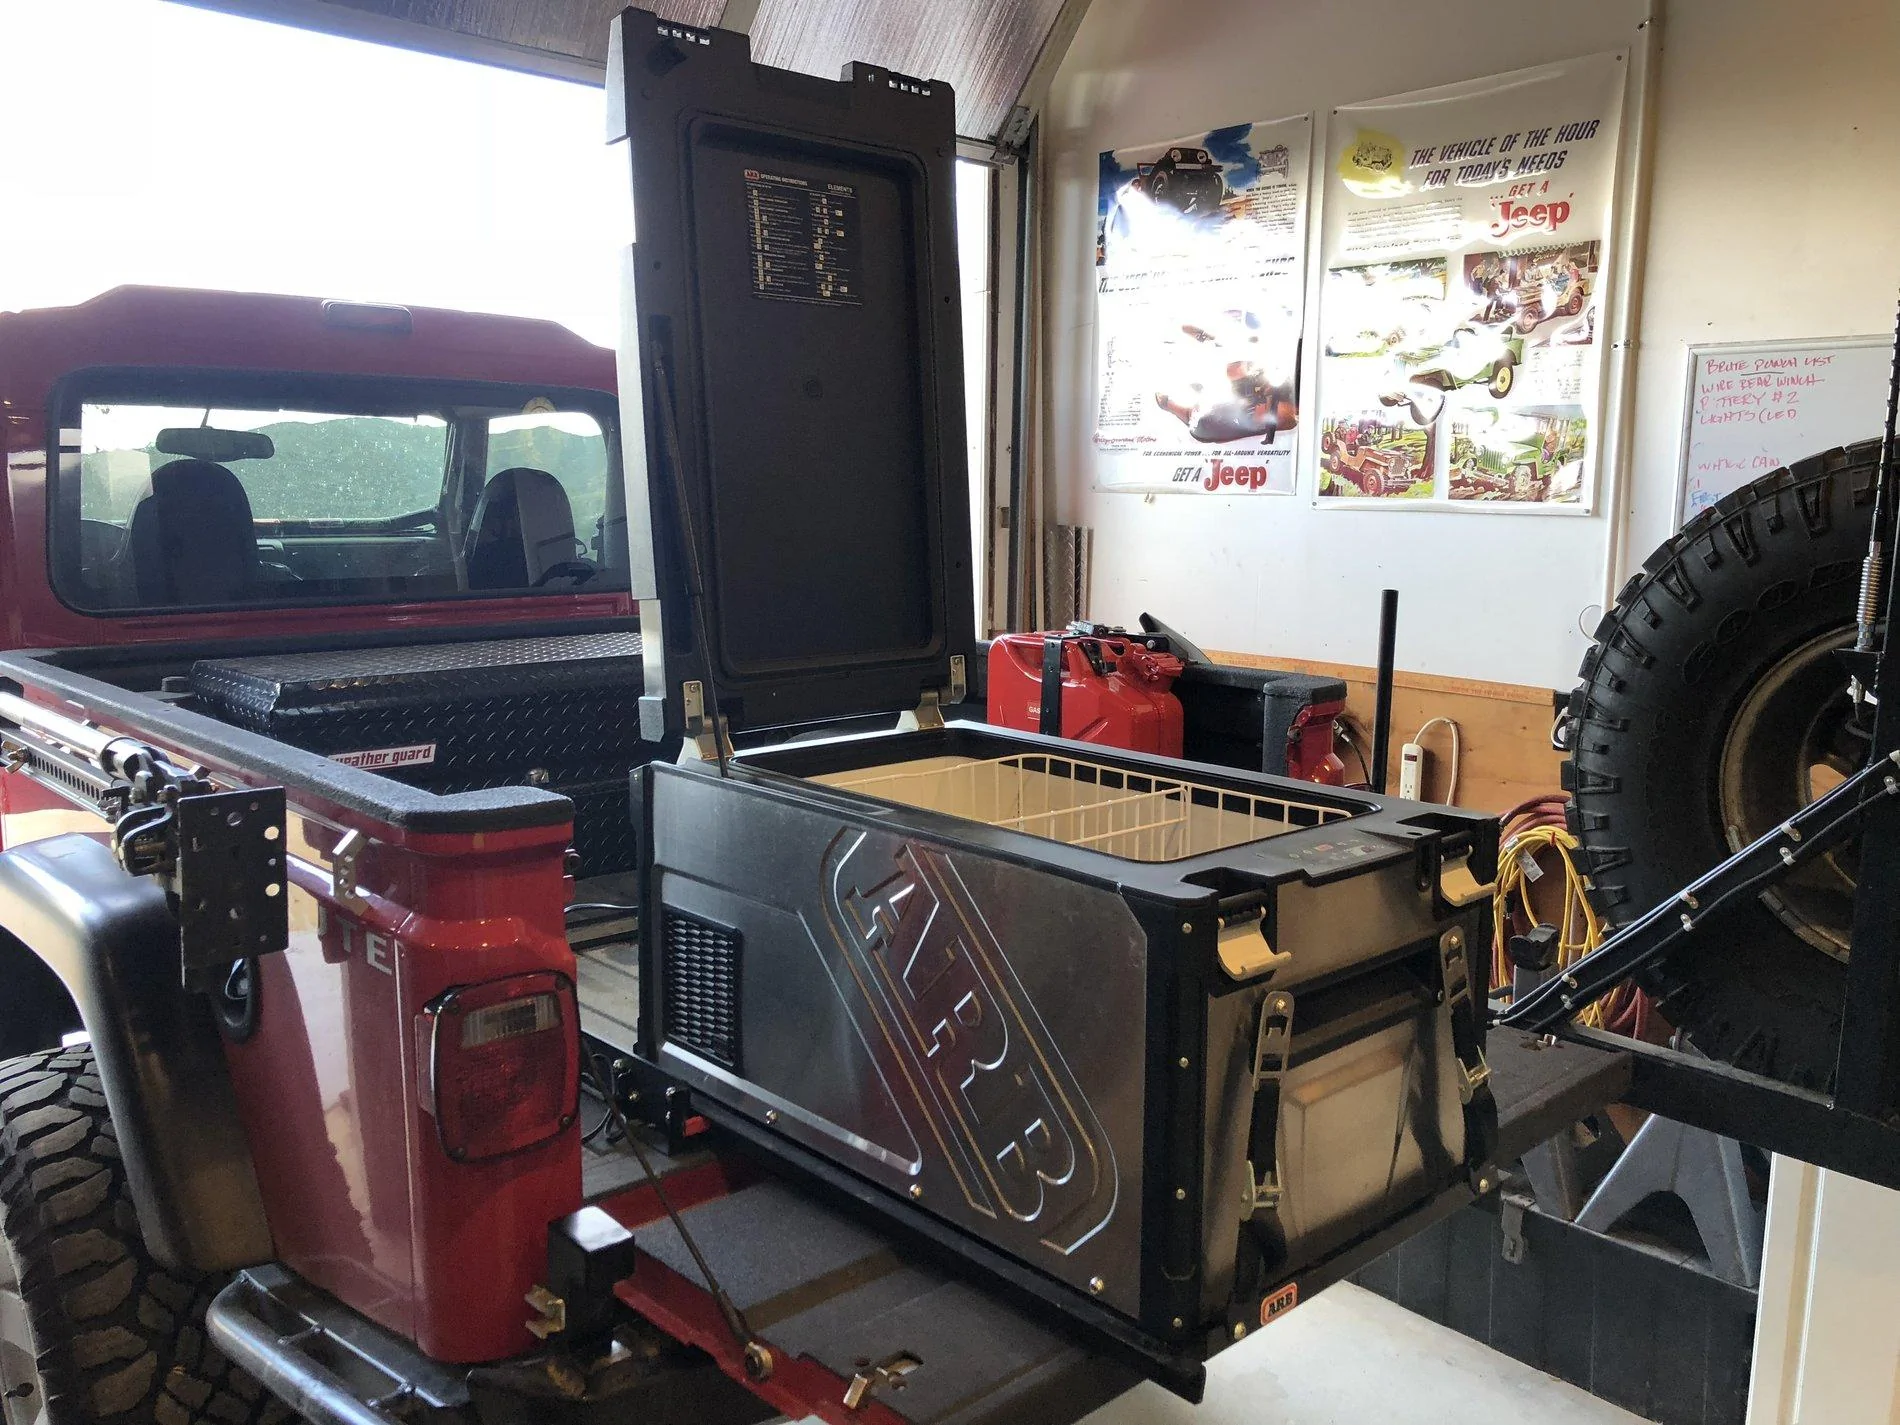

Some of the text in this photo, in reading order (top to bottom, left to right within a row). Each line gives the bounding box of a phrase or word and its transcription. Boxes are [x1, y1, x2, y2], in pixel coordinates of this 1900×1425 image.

[1410, 119, 1600, 168] THE VEHICLE OF THE HOUR
[1422, 150, 1568, 187] FOR TODAY'S NEEDS
[827, 184, 853, 194] ELEMENTS
[1509, 182, 1535, 198] GET
[1539, 180, 1550, 195] A
[1705, 359, 1749, 375] BRUTE
[1701, 373, 1826, 394] WIRE REAR WINCH
[1172, 467, 1203, 482] GET A
[391, 746, 432, 765] guard
[844, 843, 1076, 1222] ARB
[1268, 1291, 1294, 1317] ARB
